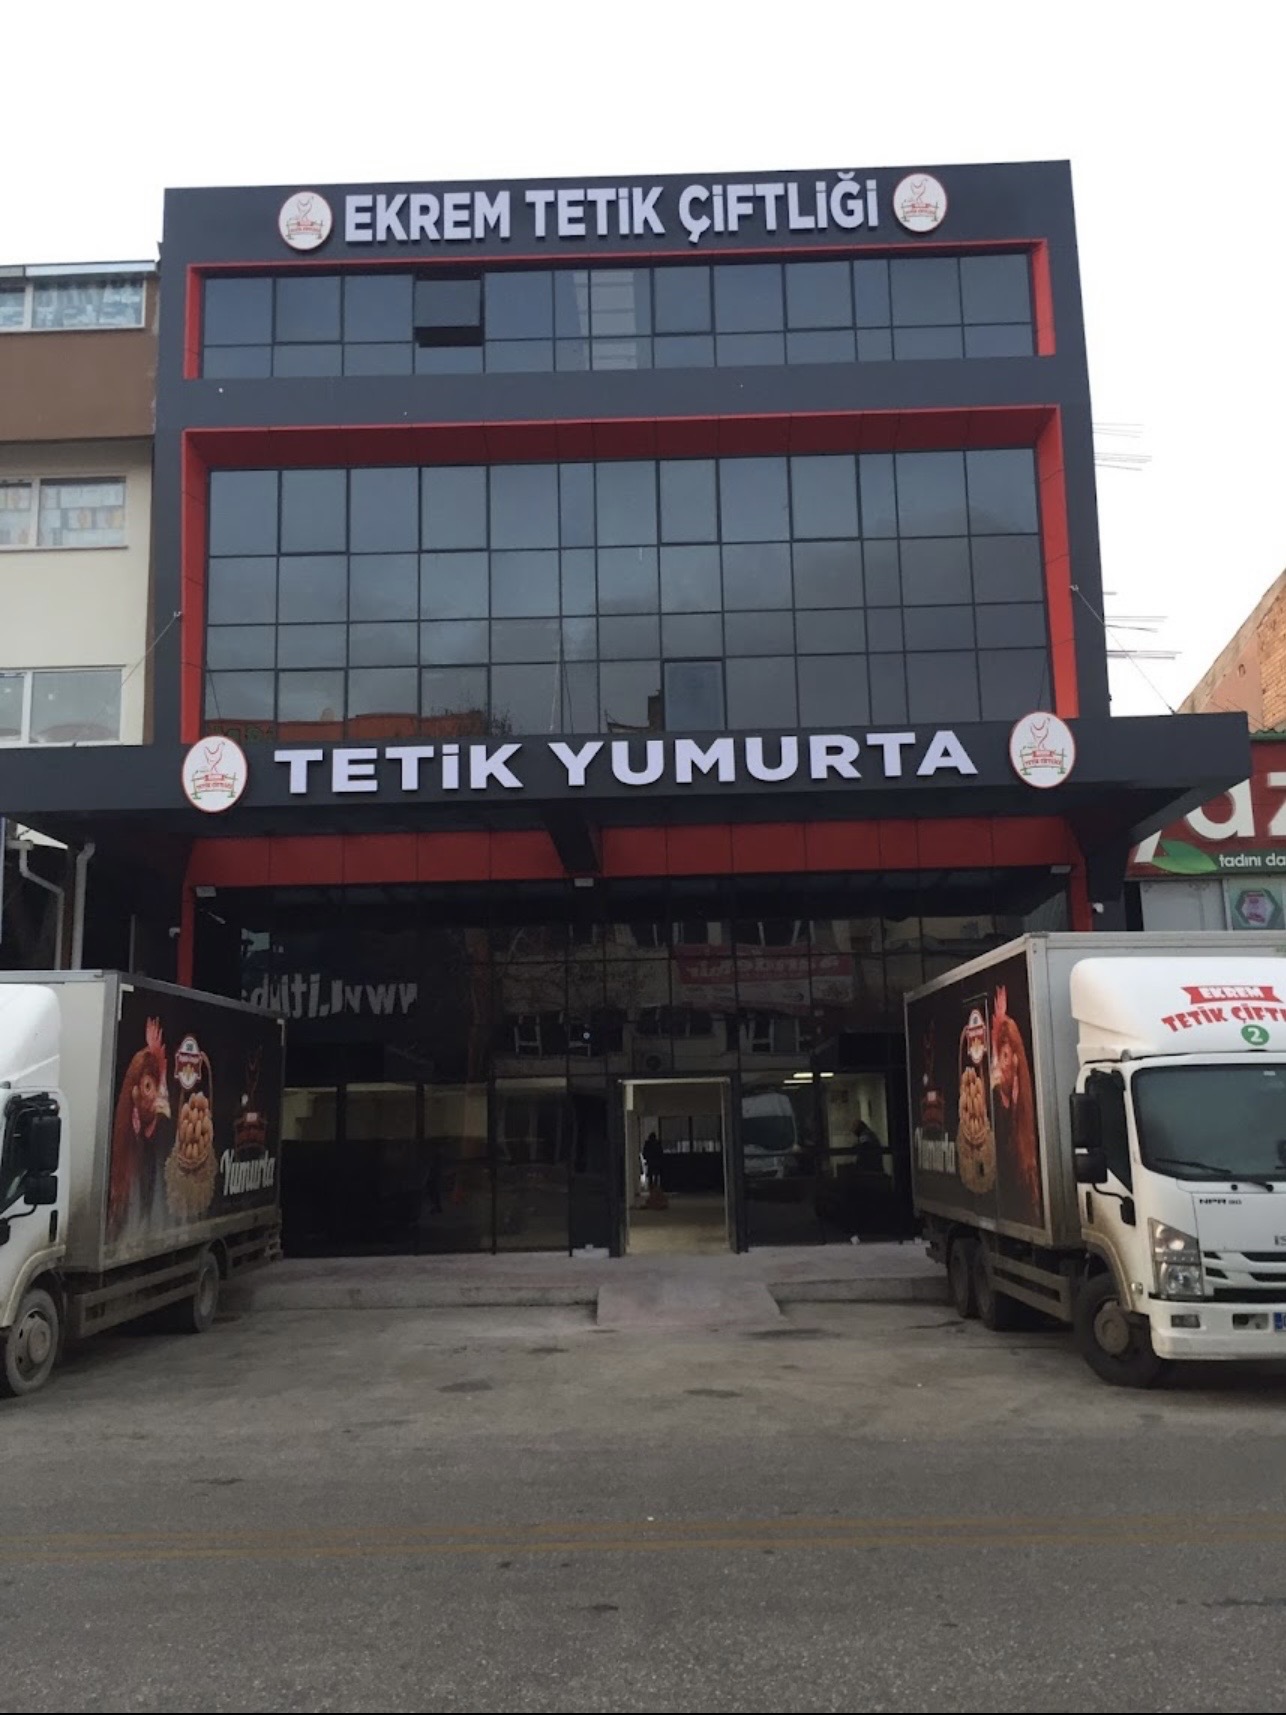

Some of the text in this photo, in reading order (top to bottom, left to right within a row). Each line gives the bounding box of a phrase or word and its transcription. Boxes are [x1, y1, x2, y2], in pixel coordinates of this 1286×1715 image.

[345, 190, 510, 242] EKREM
[548, 730, 978, 786] YUMURTA
[1198, 986, 1264, 999] EKREM
[1247, 1027, 1263, 1043] 2
[220, 1149, 275, 1196] Yumurta
